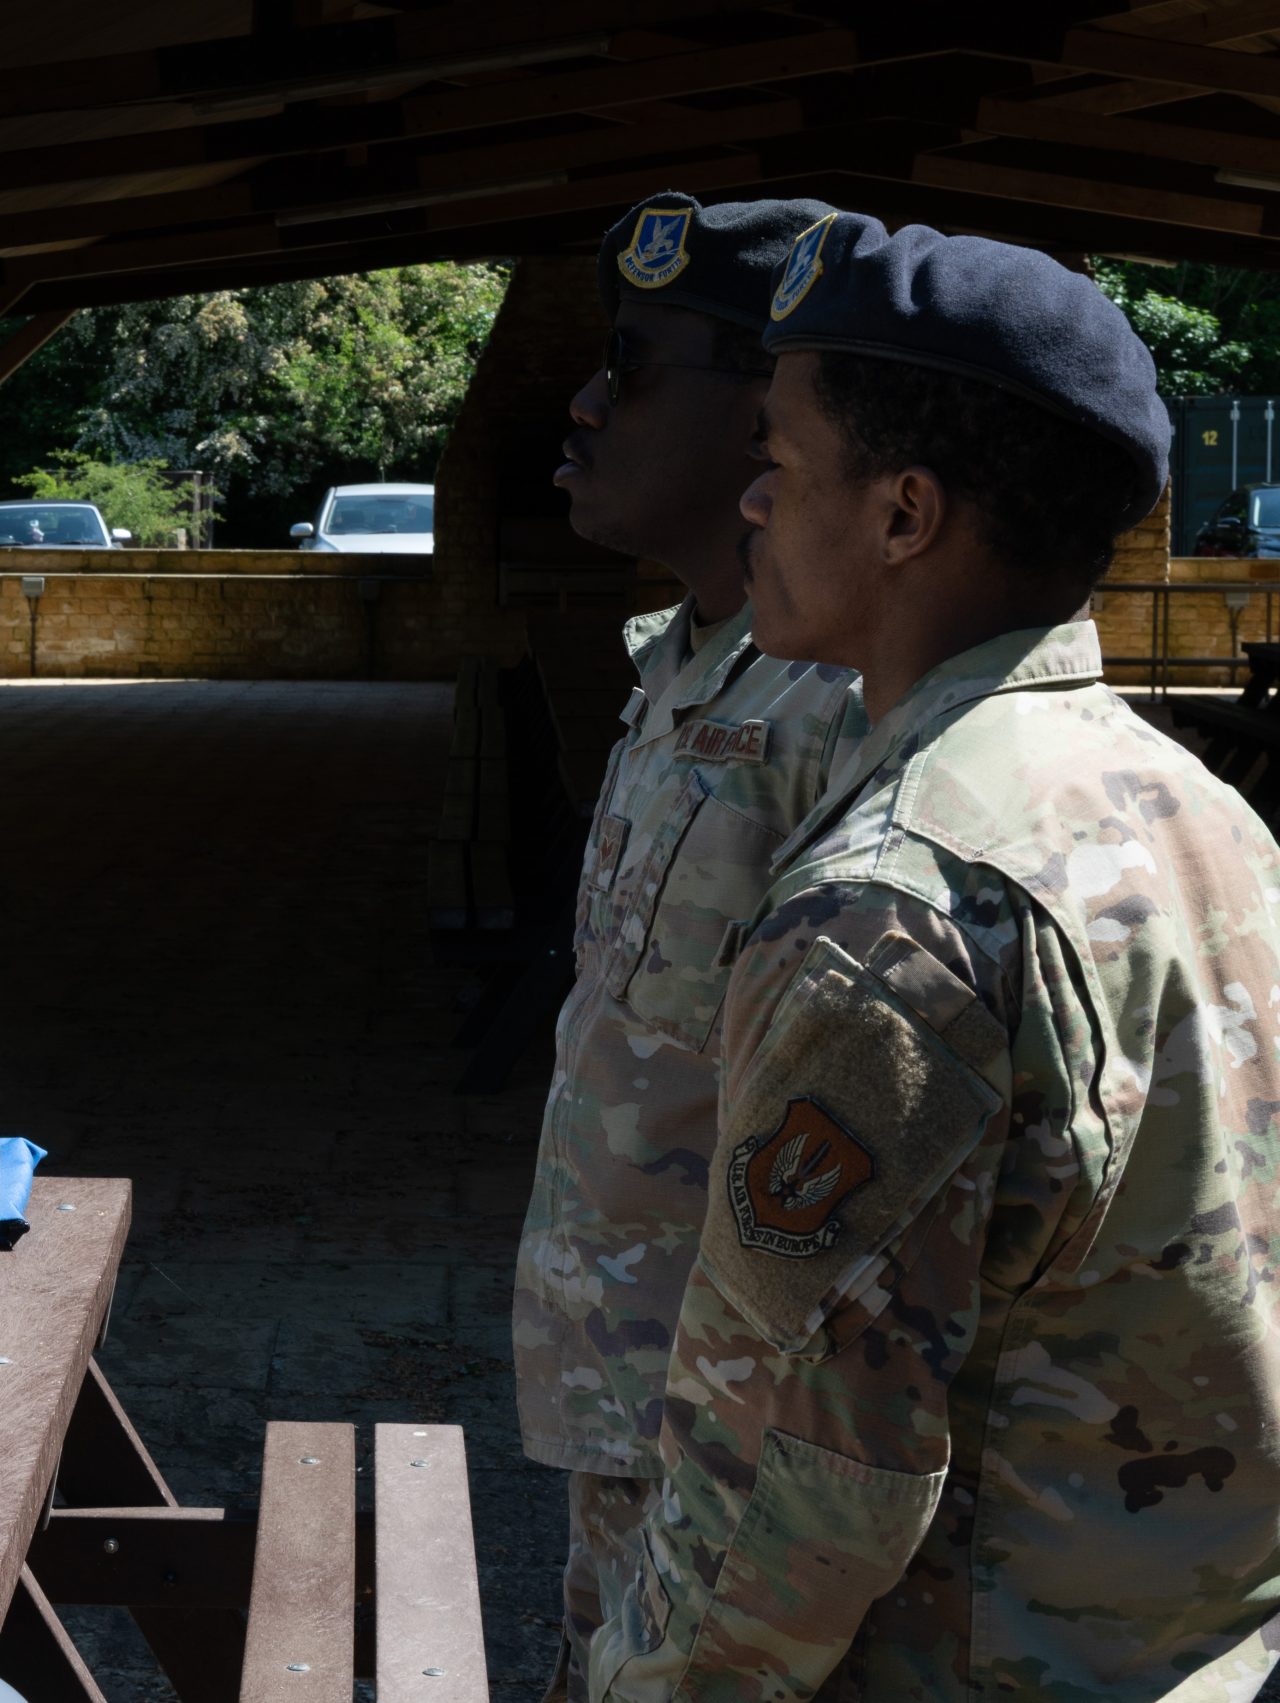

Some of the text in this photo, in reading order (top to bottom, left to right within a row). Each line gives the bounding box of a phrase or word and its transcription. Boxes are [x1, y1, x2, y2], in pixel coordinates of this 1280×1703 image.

[1201, 429, 1219, 446] 12
[691, 724, 728, 755] AIR
[776, 1234, 822, 1253] EUROPE
